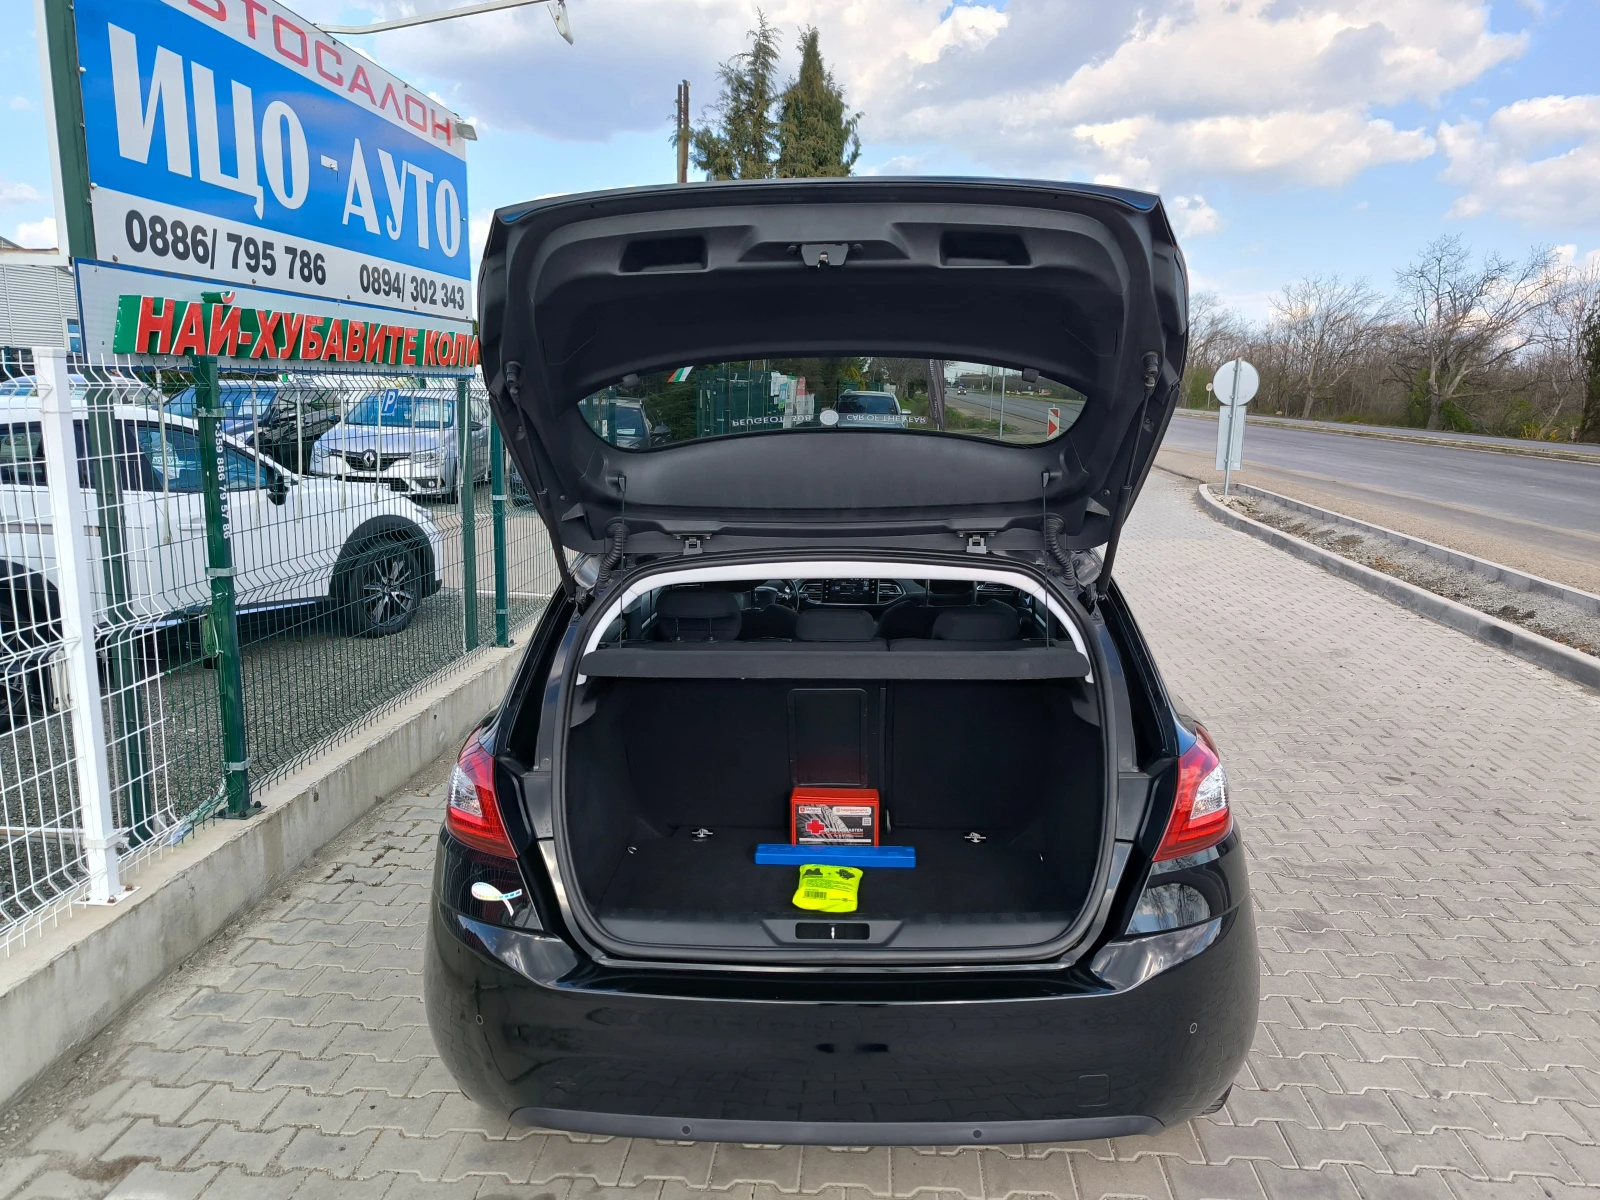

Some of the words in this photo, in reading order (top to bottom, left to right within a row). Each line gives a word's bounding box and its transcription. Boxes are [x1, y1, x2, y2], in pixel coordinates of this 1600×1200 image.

[125, 209, 217, 270] 0886/
[226, 232, 276, 277] 795
[284, 246, 327, 286] 786
[359, 263, 407, 304] 0894/
[410, 275, 438, 307] 302
[441, 282, 466, 312] 343
[134, 290, 417, 366] НАЙ-ХУБАВИТЕ
[423, 329, 479, 368] КОЛИ
[215, 421, 224, 453] +359
[216, 457, 226, 481] 886
[219, 484, 227, 500] 79
[220, 504, 230, 519] 57
[222, 523, 231, 539] 86
